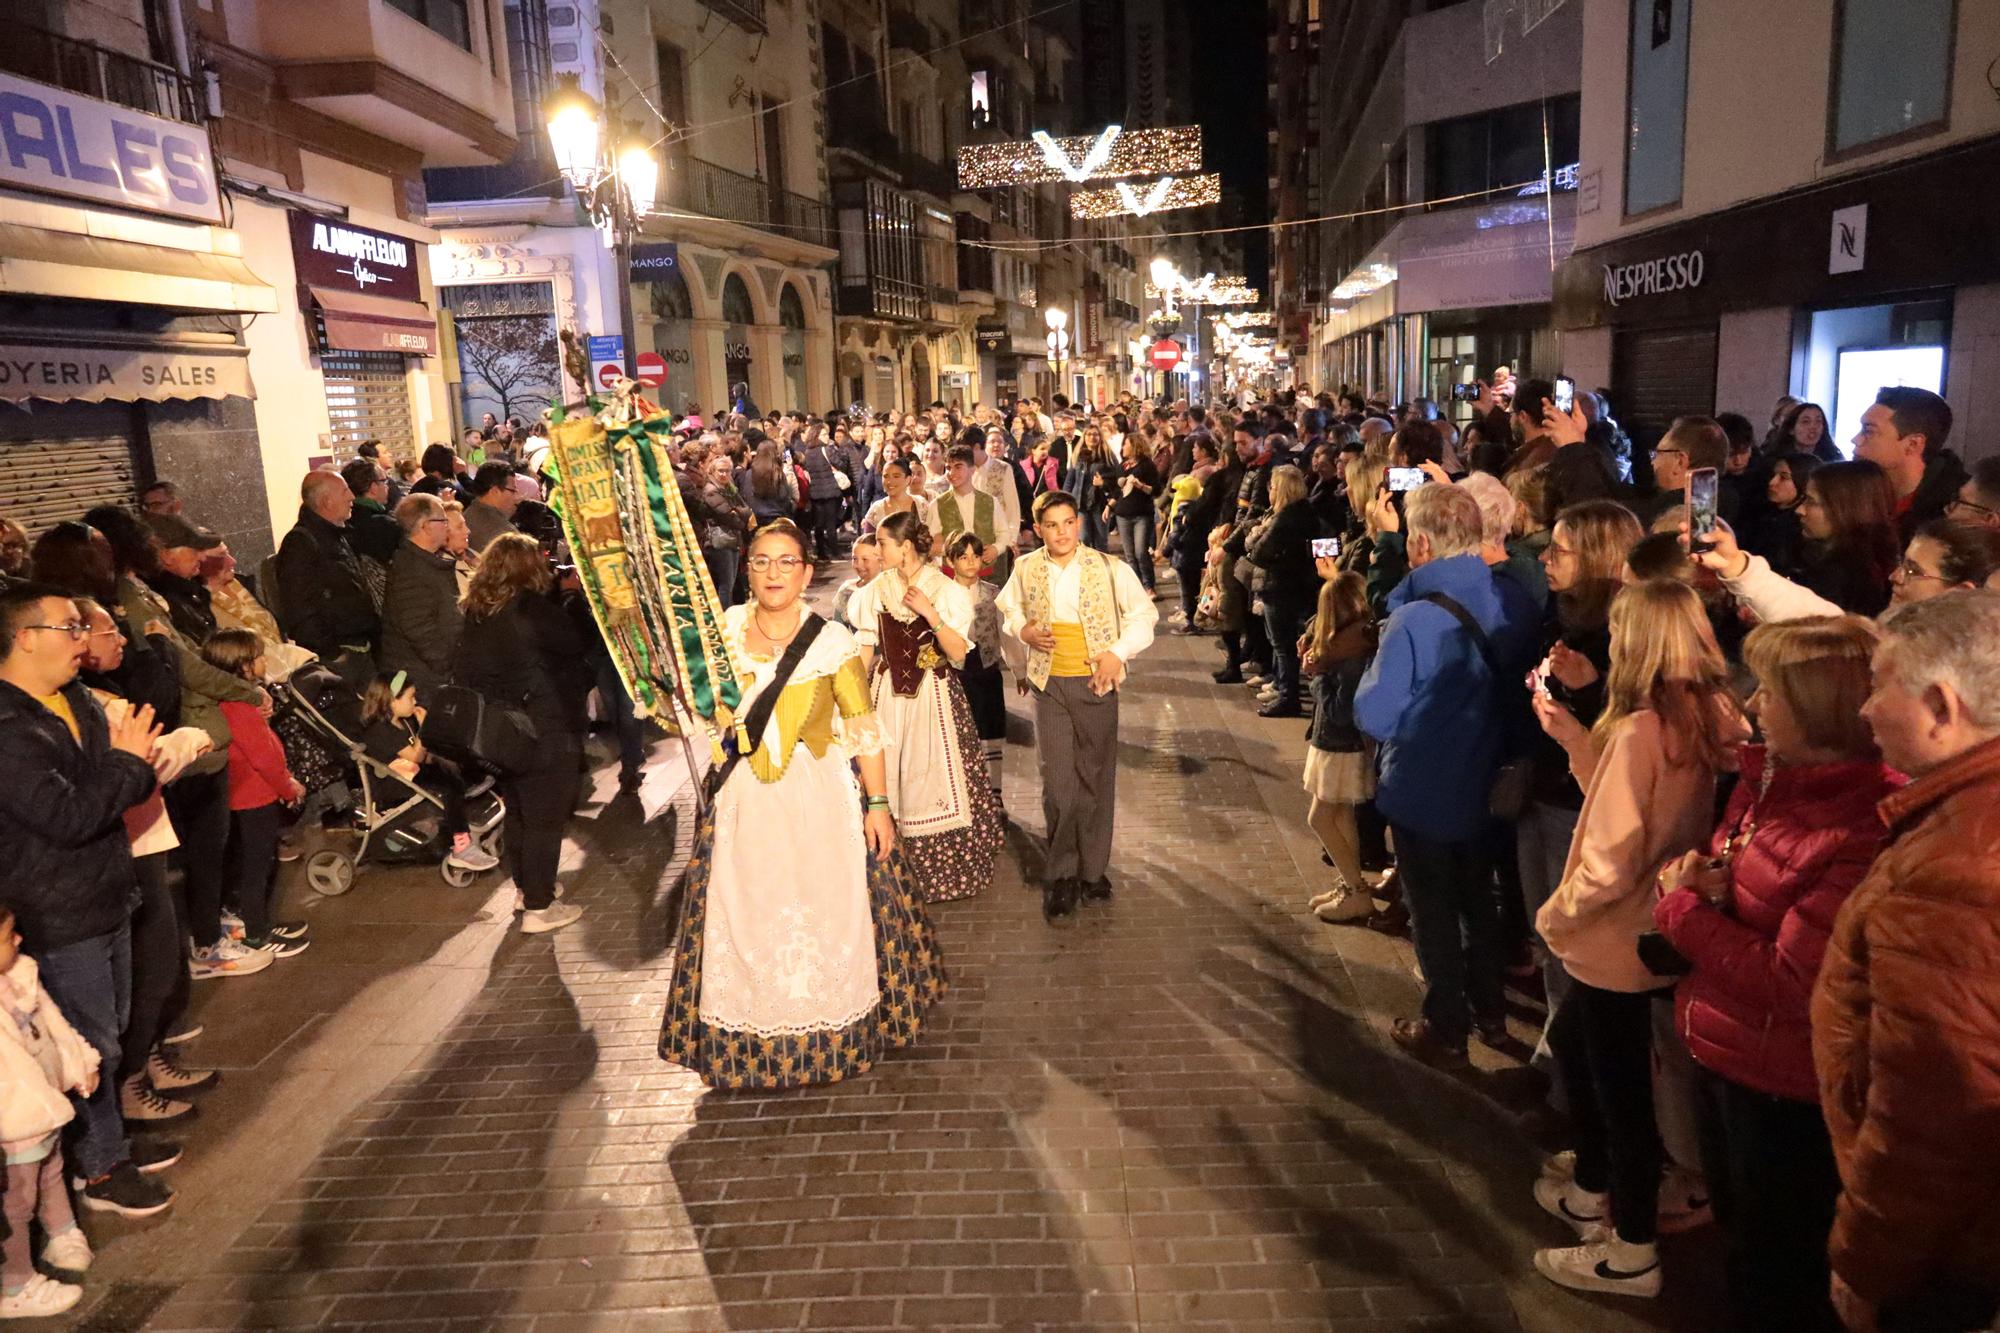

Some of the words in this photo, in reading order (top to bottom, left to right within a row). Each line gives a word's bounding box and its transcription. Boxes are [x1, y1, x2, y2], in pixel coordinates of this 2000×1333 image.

[0, 91, 210, 206] ALES
[630, 257, 673, 268] MANGO
[1603, 250, 1704, 306] NESPRESSO
[724, 343, 752, 359] ANGO
[0, 361, 115, 385] OYERIA
[142, 365, 216, 385] SALES
